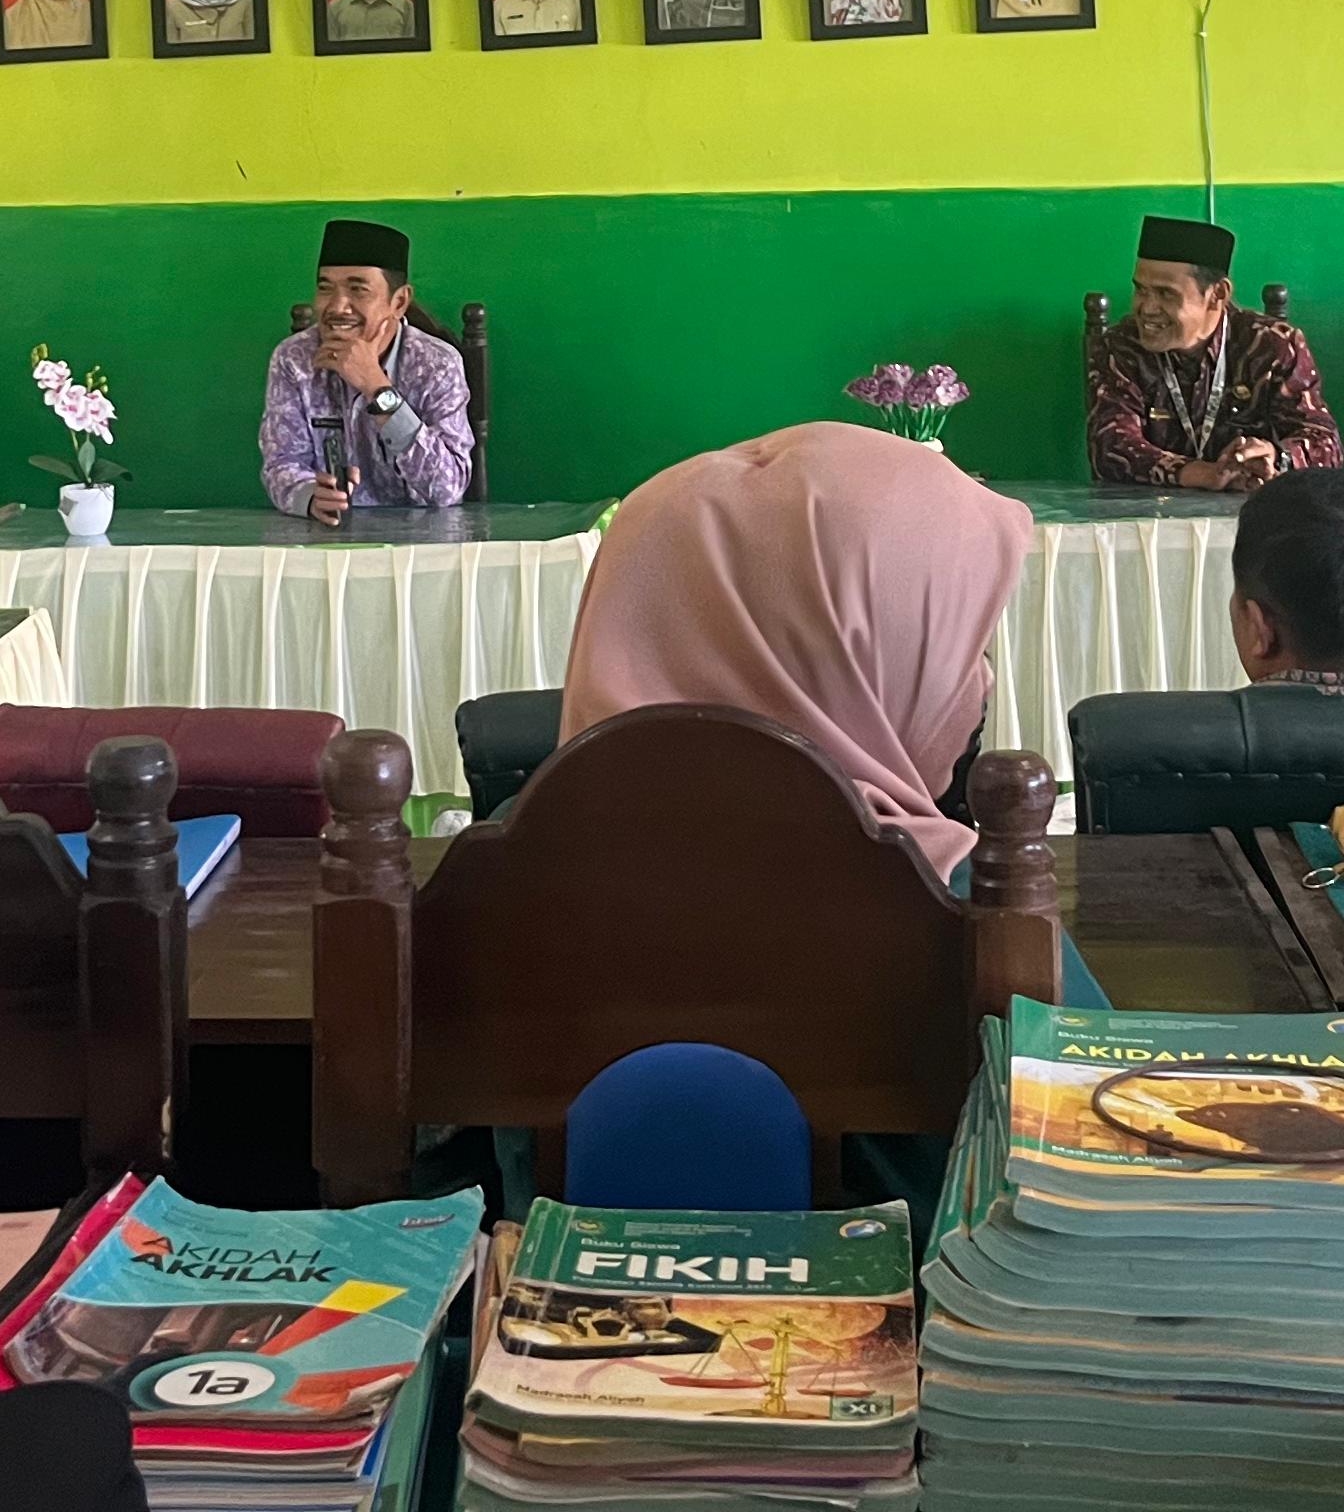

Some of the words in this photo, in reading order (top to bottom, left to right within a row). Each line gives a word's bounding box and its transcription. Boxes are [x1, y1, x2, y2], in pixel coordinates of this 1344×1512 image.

[1061, 1043, 1205, 1062] AKIDAH
[143, 1236, 322, 1264] AKIDAH
[581, 1237, 623, 1248] Buku
[130, 1253, 338, 1283] AKHLAK
[576, 1251, 809, 1283] FIKIH
[186, 1368, 250, 1396] 1a
[517, 1384, 591, 1400] Madrasah
[849, 1404, 876, 1414] XI
